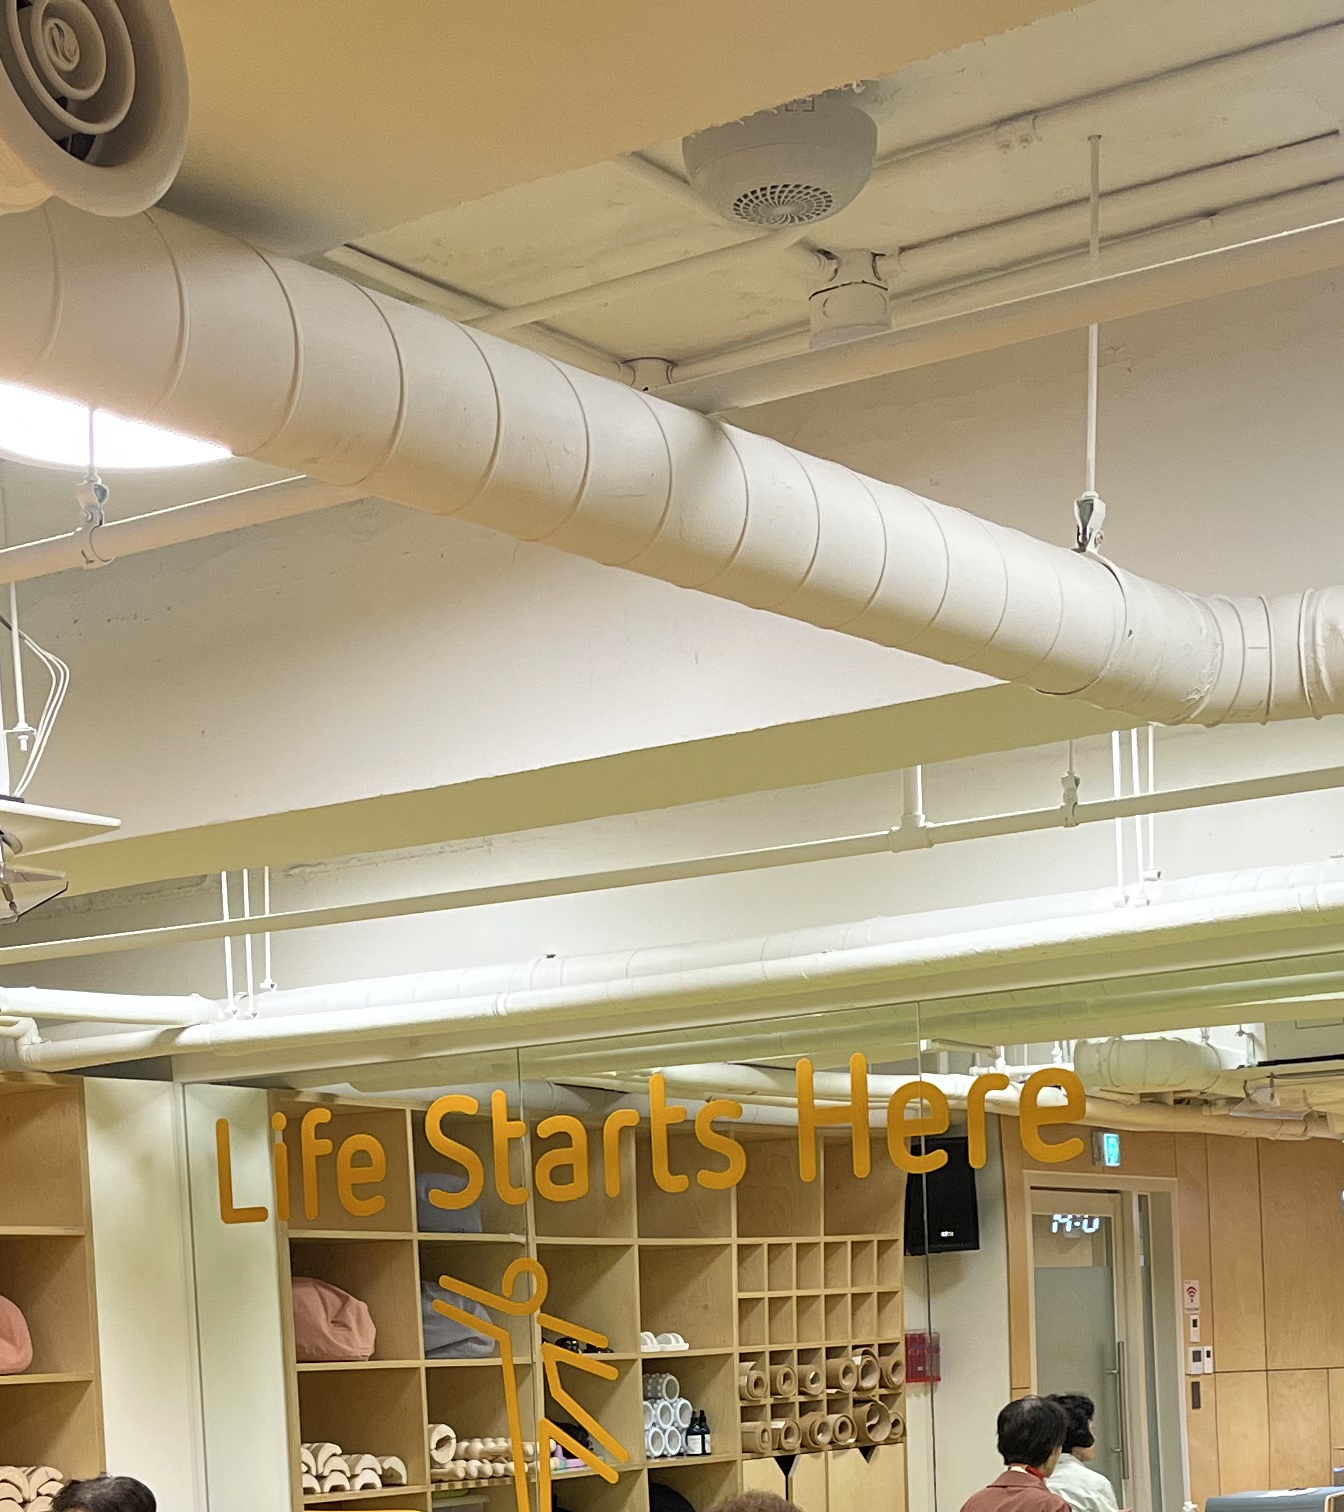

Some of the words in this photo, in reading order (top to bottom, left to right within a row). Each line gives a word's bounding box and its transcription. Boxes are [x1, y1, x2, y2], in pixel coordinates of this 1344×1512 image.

[215, 1107, 388, 1224] Life
[424, 1072, 747, 1211] Starts
[796, 1052, 1087, 1183] Here
